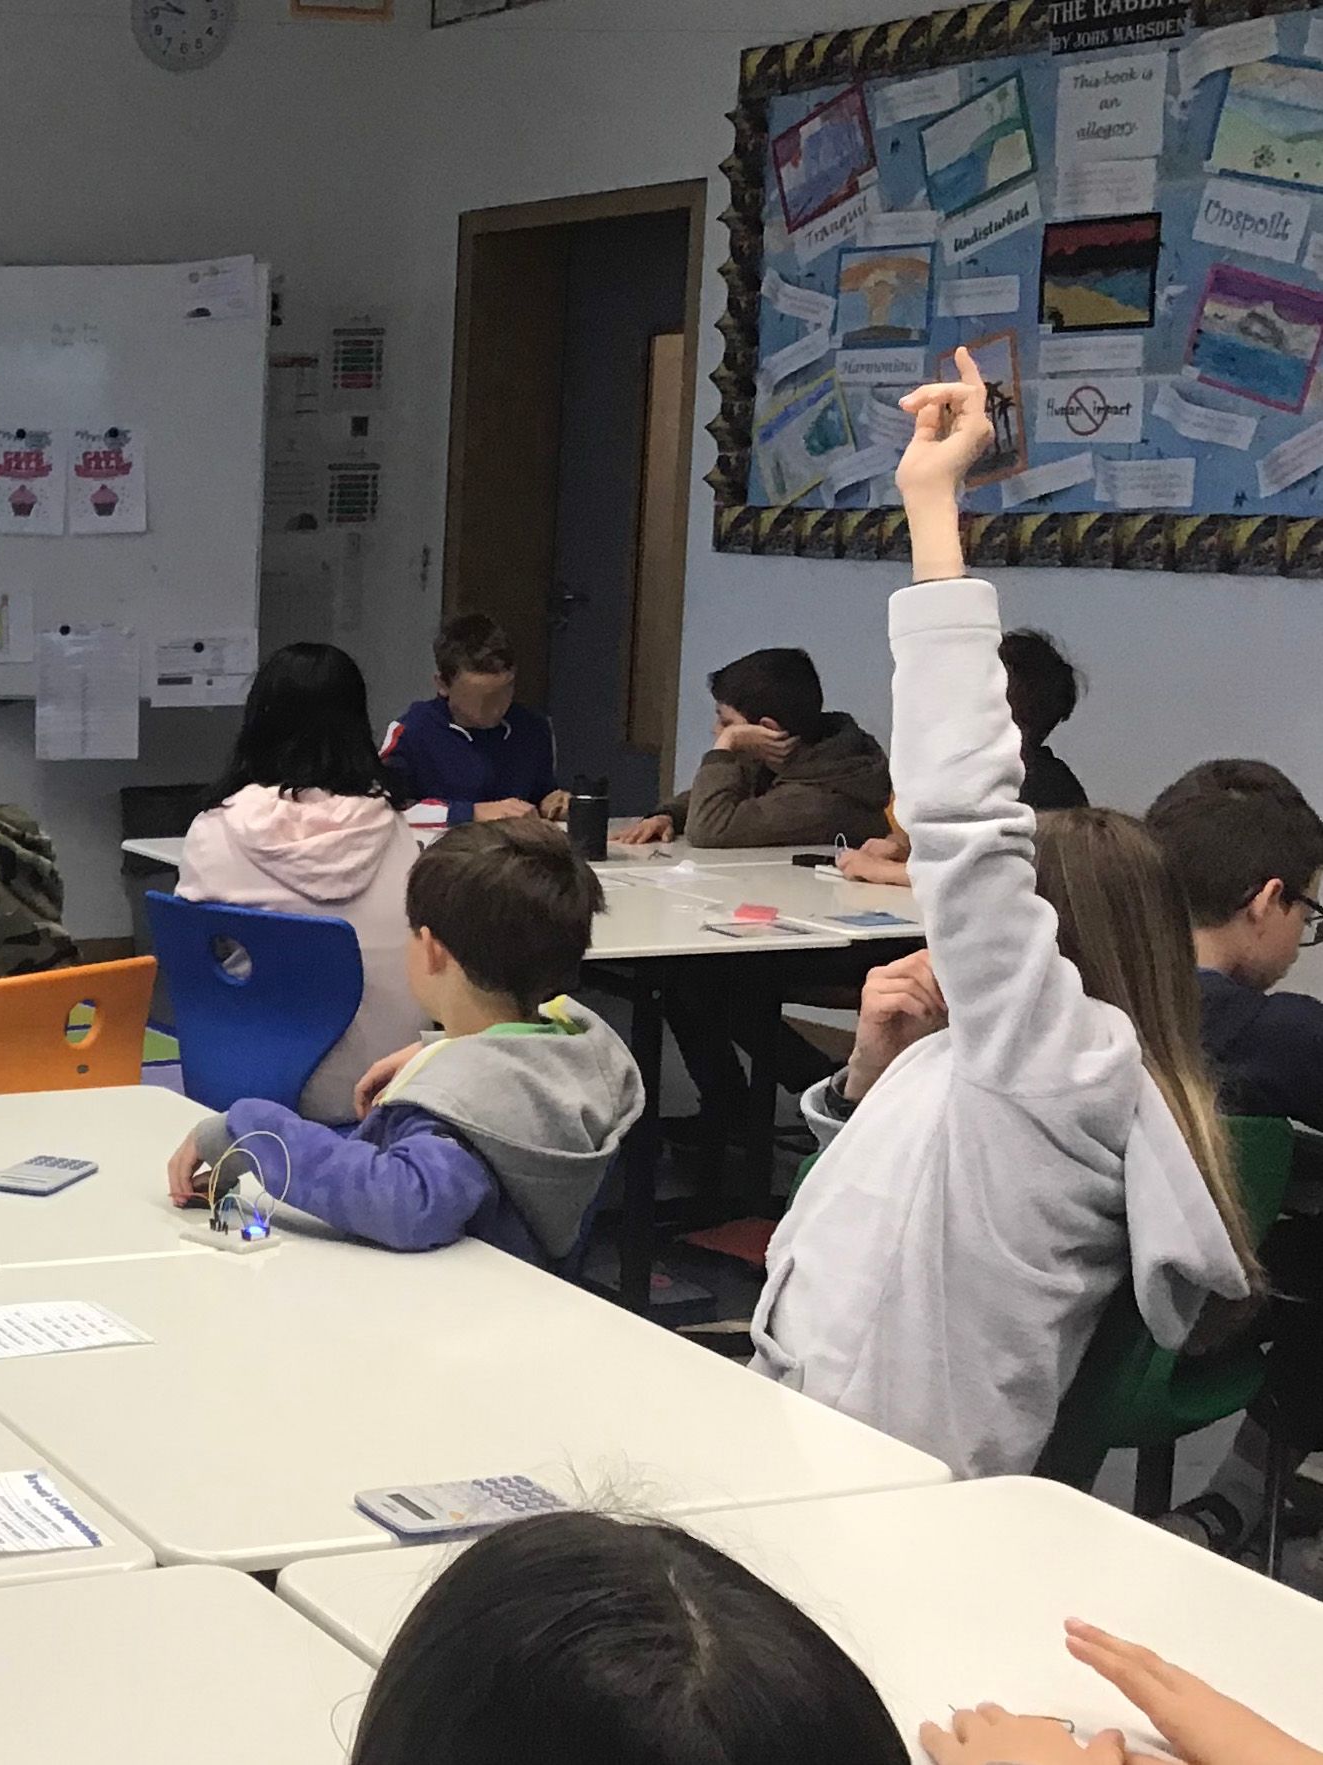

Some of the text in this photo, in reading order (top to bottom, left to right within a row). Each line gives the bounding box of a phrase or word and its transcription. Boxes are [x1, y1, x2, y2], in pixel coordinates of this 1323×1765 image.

[1049, 0, 1087, 24] THE
[1073, 30, 1109, 48] JOHN
[1112, 17, 1185, 41] MARSDEN
[1073, 66, 1154, 89] This book is
[1099, 97, 1121, 111] an
[1204, 199, 1293, 242] Unspoilt
